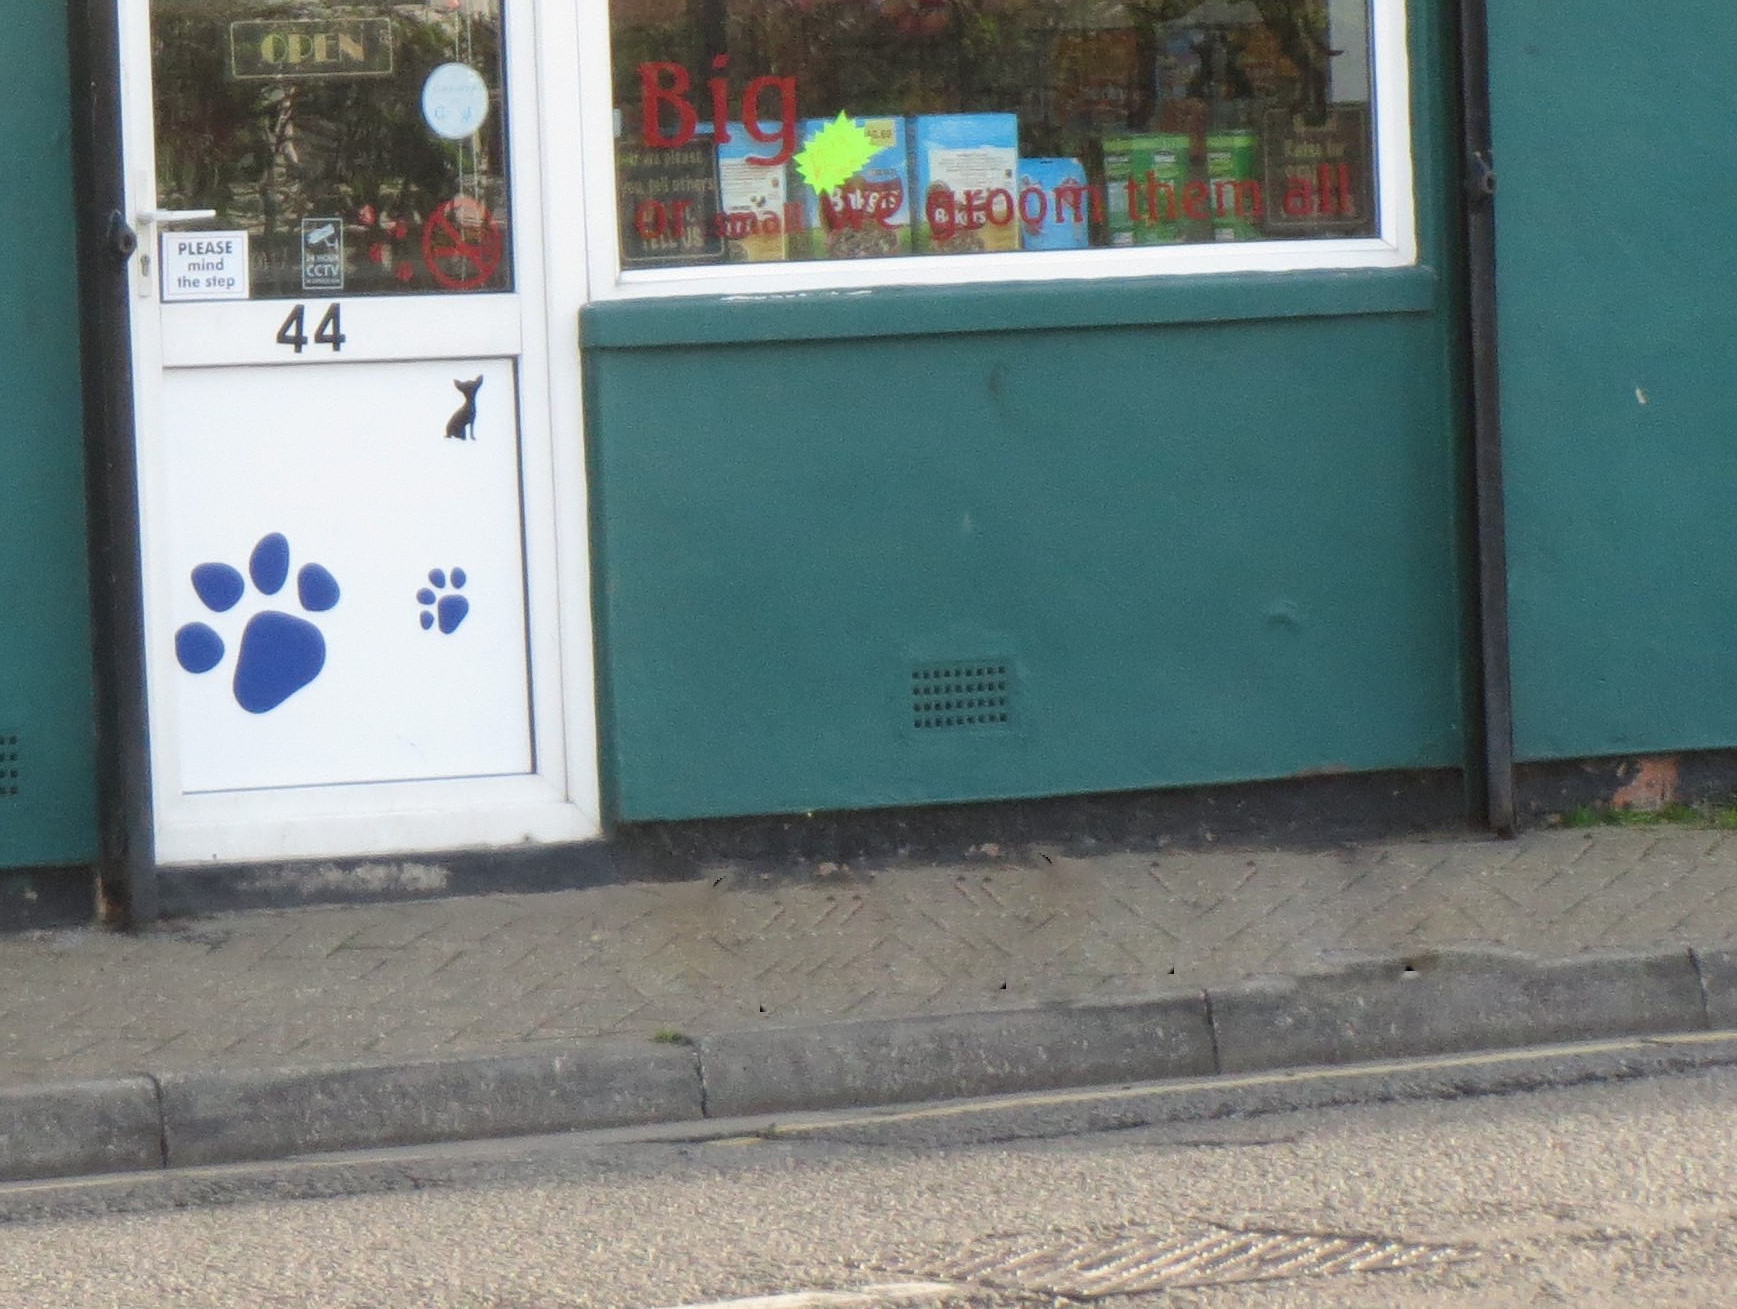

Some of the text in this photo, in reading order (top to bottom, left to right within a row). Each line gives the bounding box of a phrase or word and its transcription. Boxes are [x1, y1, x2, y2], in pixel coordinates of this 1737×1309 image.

[261, 33, 365, 64] OPEN
[637, 54, 800, 167] Big
[635, 199, 695, 240] or
[714, 200, 806, 238] small
[925, 187, 1106, 244] groom
[1124, 170, 1265, 223] them
[1283, 161, 1354, 216] all
[178, 240, 233, 256] PLEASE
[188, 257, 224, 271] mind
[306, 263, 340, 278] CCTV
[178, 275, 236, 290] the step
[276, 303, 346, 354] 44
